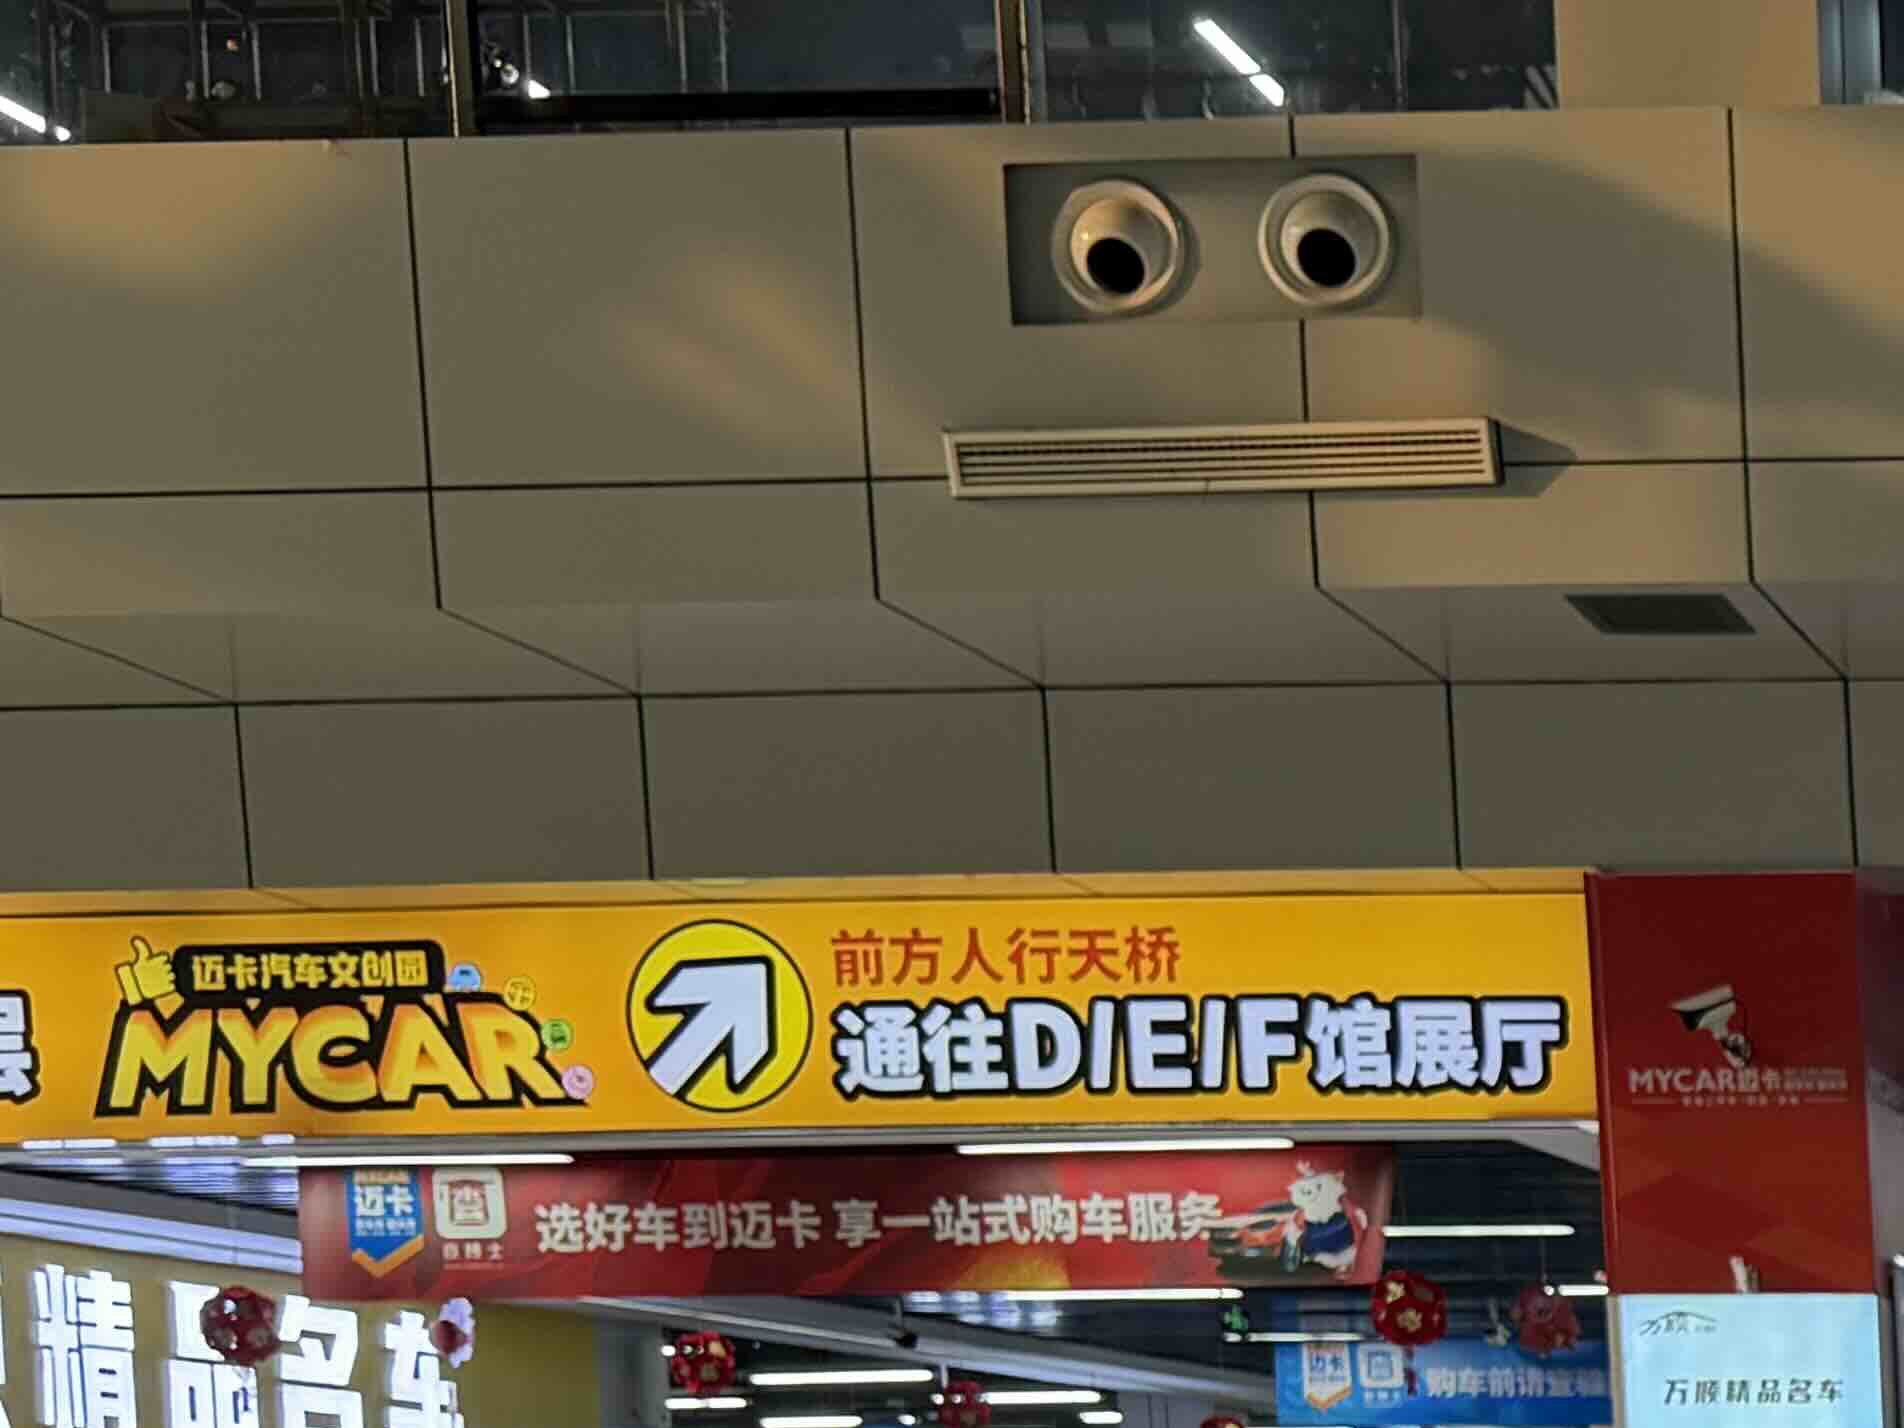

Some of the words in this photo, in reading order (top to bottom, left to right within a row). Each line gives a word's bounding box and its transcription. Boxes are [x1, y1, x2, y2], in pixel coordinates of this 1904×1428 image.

[191, 949, 429, 991] 迈卡汽车文创园
[830, 926, 1181, 986] 前方人行天桥
[104, 998, 580, 1114] MYCAR
[836, 998, 1562, 1094] 通往D/E/F馆展厅
[535, 1200, 822, 1254] 选好车到迈卡
[834, 1190, 1223, 1247] 享一站式购车服务
[1664, 1378, 1844, 1405] 万顺精品名车
